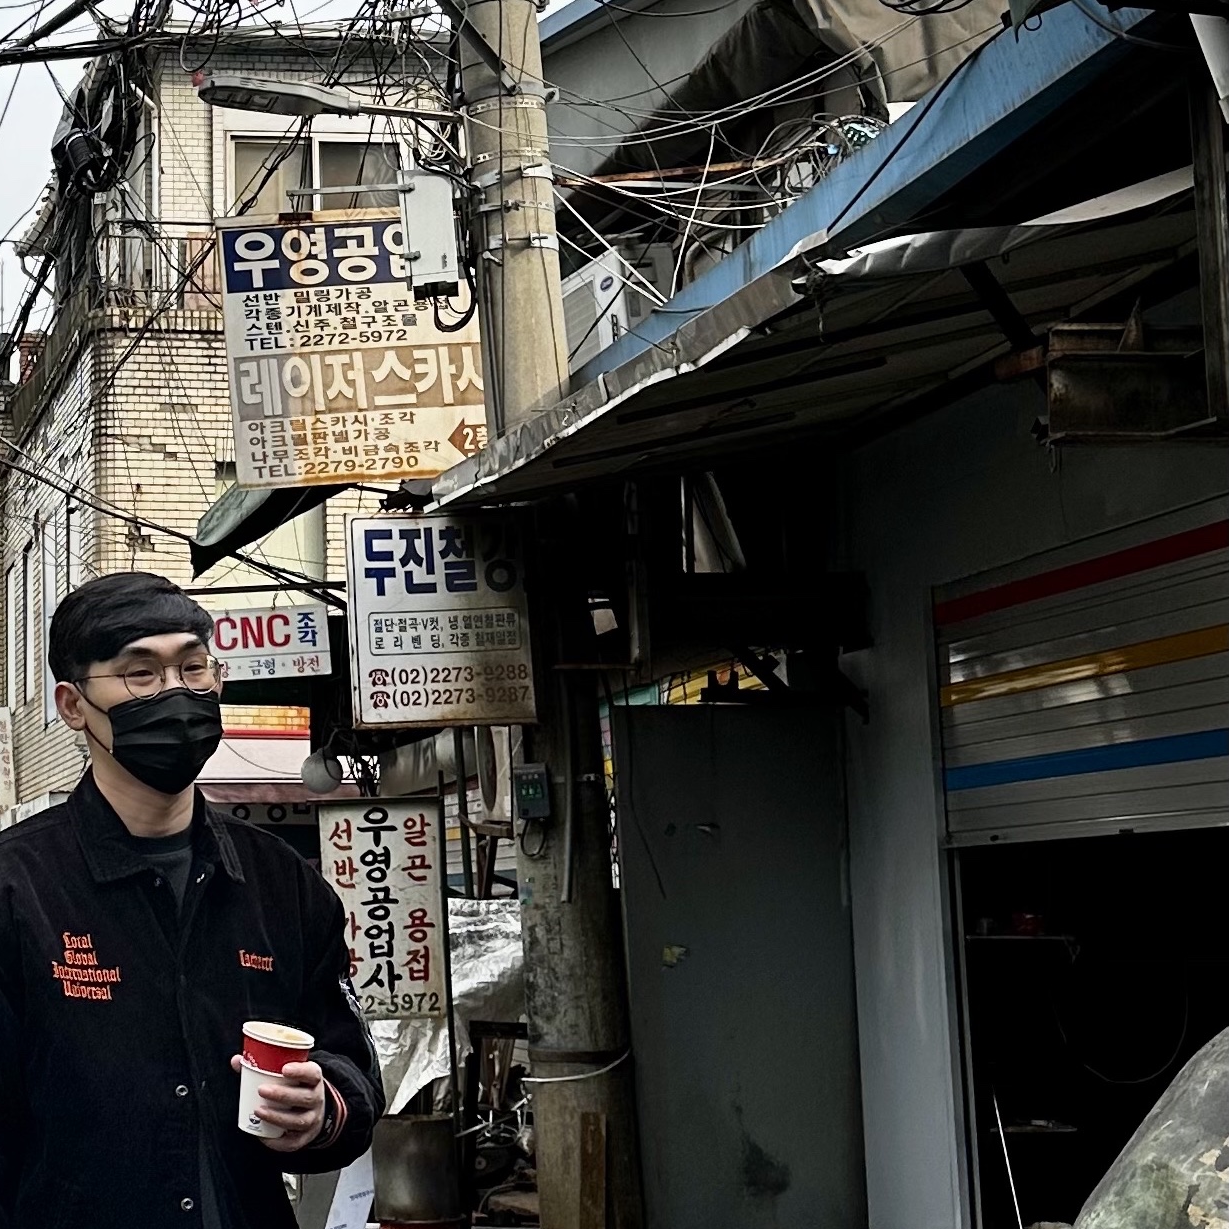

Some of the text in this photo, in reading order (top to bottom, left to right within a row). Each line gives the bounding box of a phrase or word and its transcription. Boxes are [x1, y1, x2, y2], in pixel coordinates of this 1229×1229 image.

[242, 292, 281, 308] 선반
[215, 612, 318, 651] CNC 조각
[329, 818, 359, 889] 선반
[357, 807, 403, 993] 우영공업사
[402, 813, 435, 982] 알곤 용접
[63, 931, 92, 948] Local
[64, 950, 98, 965] Global
[52, 961, 121, 982] International
[63, 980, 112, 1000] Universal
